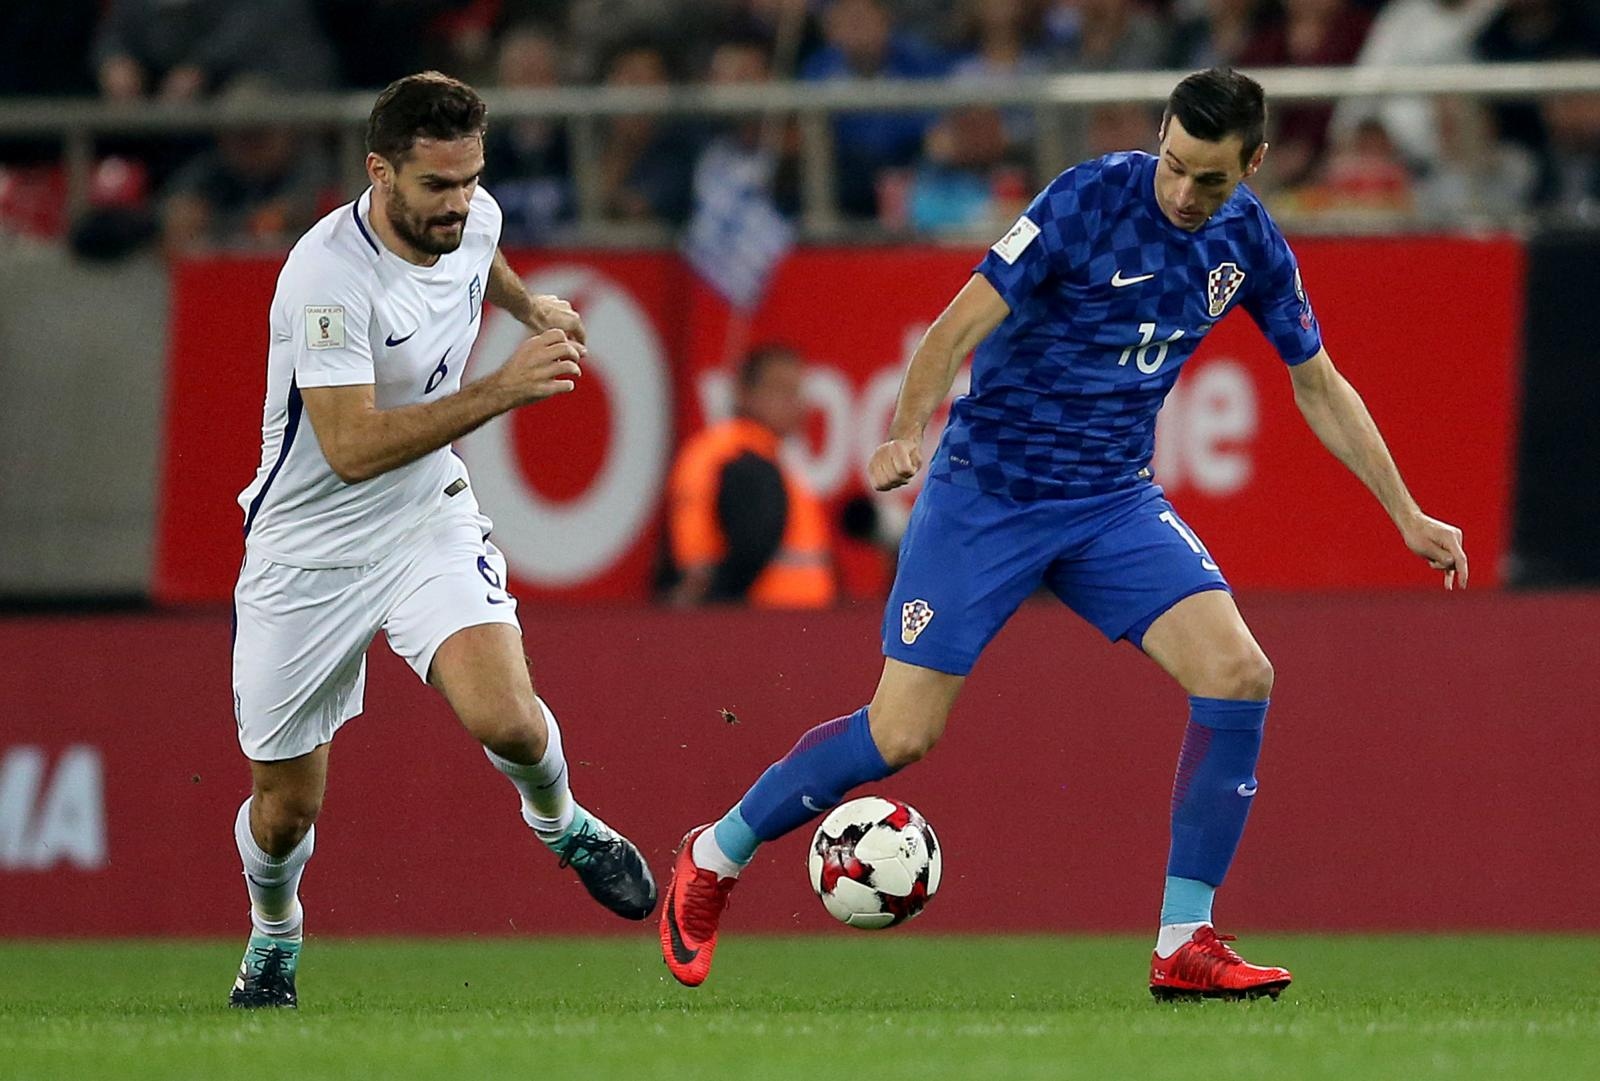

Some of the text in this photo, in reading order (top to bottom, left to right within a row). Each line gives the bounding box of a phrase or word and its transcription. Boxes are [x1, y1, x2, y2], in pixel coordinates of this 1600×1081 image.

[424, 345, 454, 394] 6
[1118, 322, 1185, 374] 16
[476, 555, 502, 590] 6
